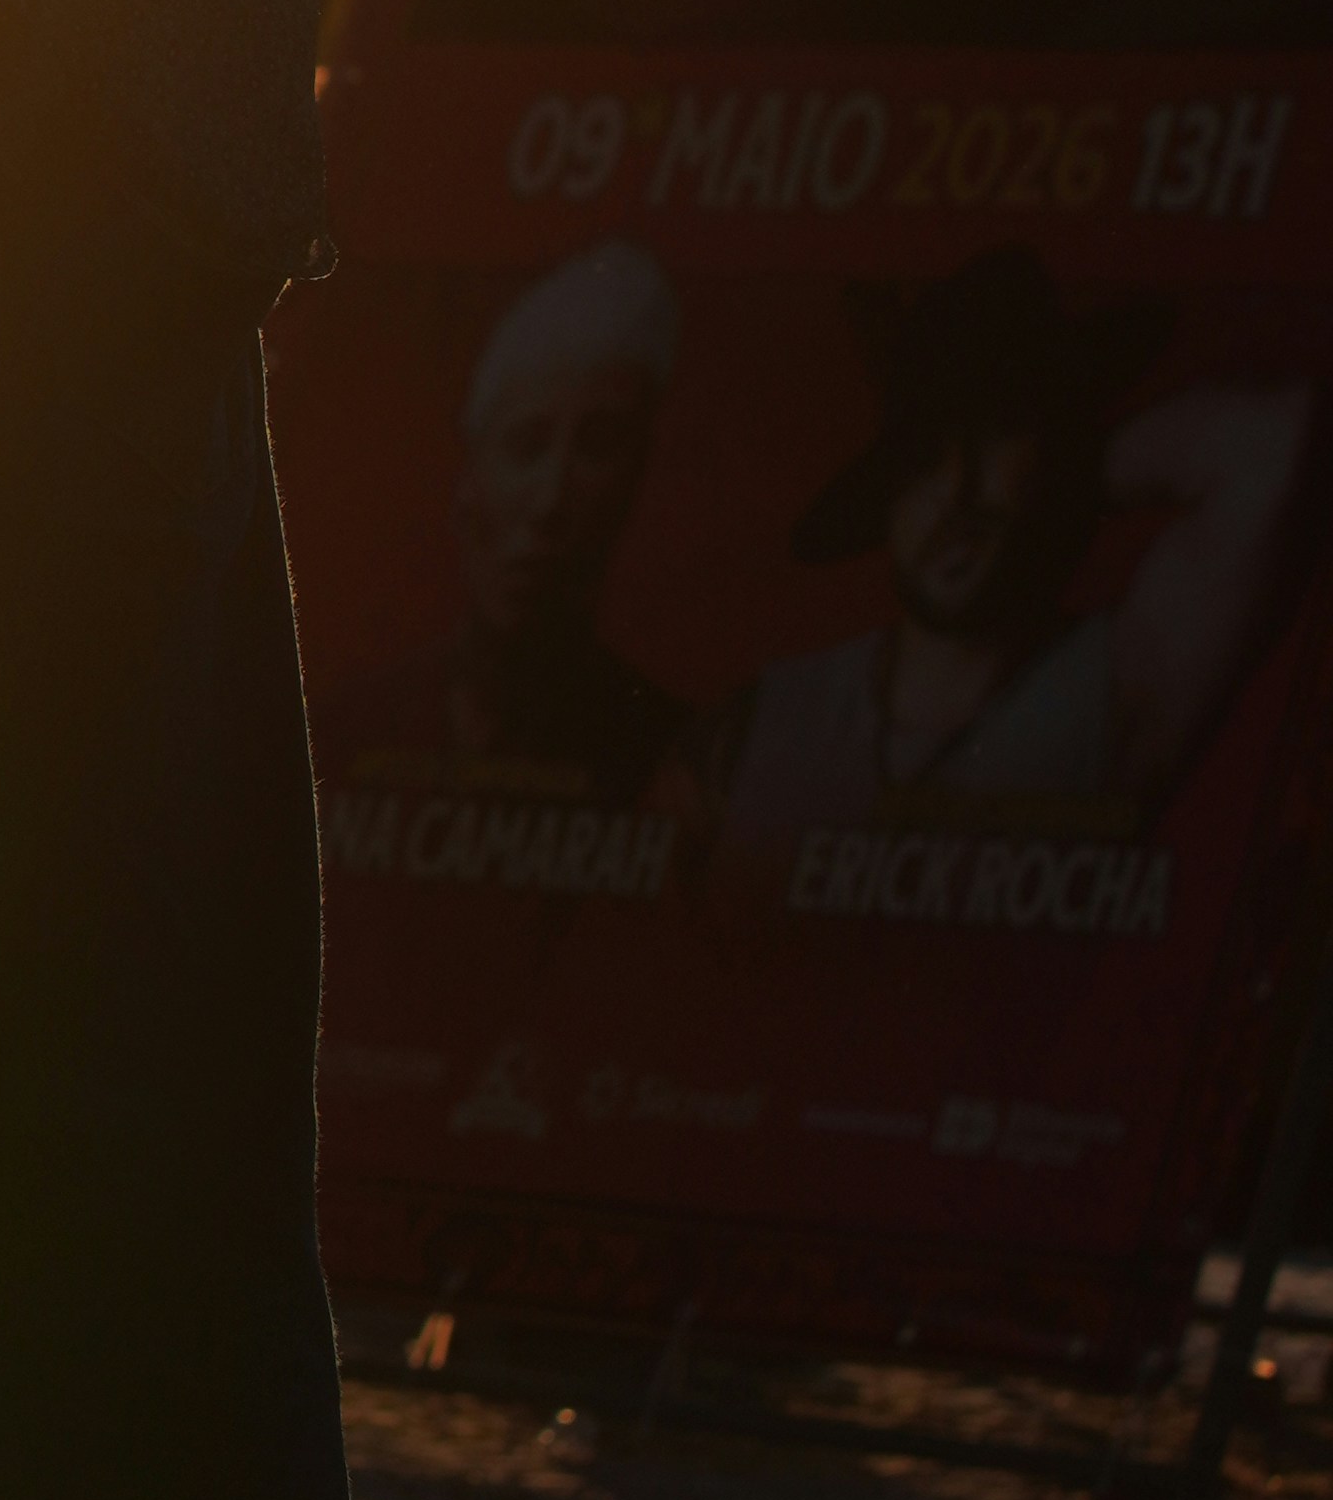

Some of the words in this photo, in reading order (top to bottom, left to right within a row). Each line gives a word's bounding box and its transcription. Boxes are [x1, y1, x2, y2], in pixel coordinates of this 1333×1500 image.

[507, 93, 623, 202] 09
[642, 88, 891, 211] MAIO
[894, 99, 1118, 207] 2026
[1132, 89, 1294, 220] 13H
[787, 828, 970, 924] ERICK
[963, 838, 1176, 938] ROCHA
